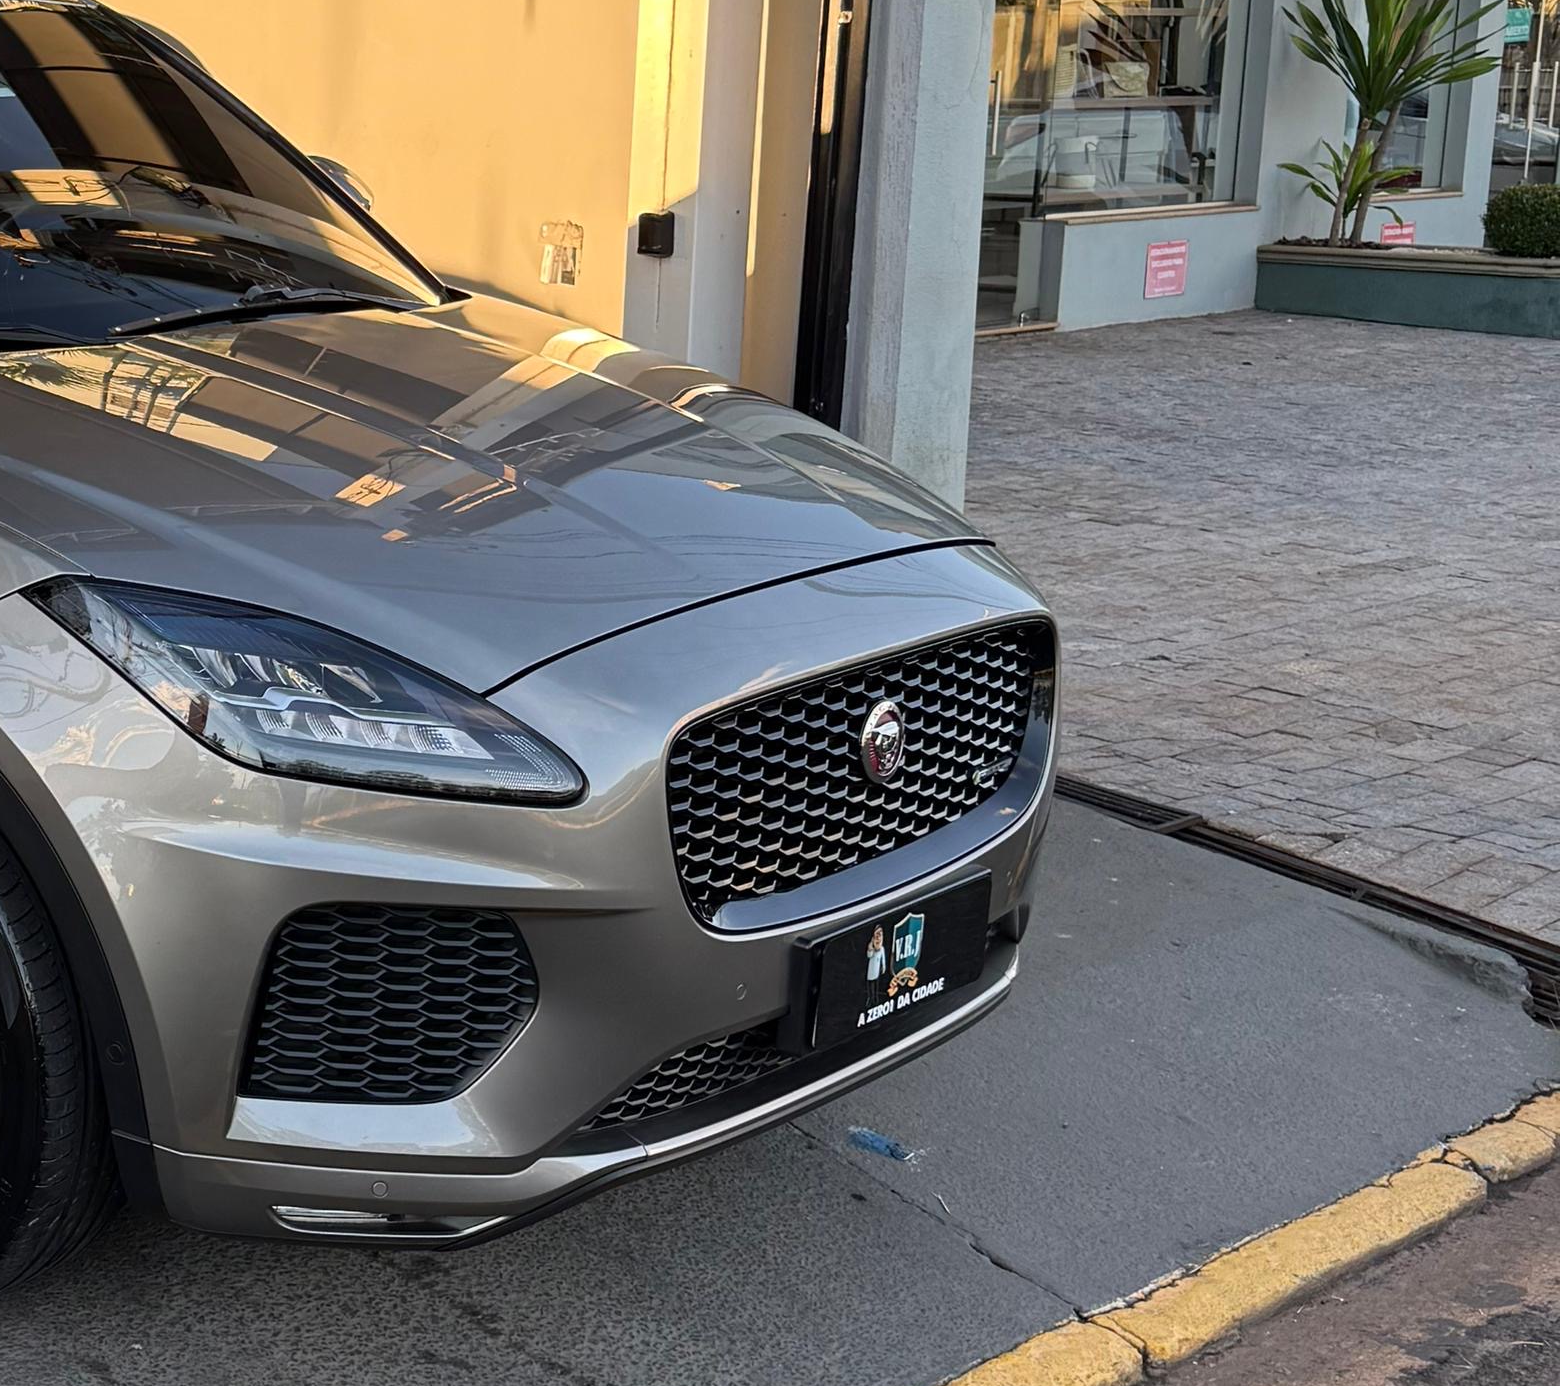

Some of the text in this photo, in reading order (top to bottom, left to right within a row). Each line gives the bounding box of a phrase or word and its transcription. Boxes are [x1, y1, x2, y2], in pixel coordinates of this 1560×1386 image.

[857, 1012, 866, 1028] A
[896, 992, 911, 1009] DA
[911, 977, 945, 1002] CIDADE
